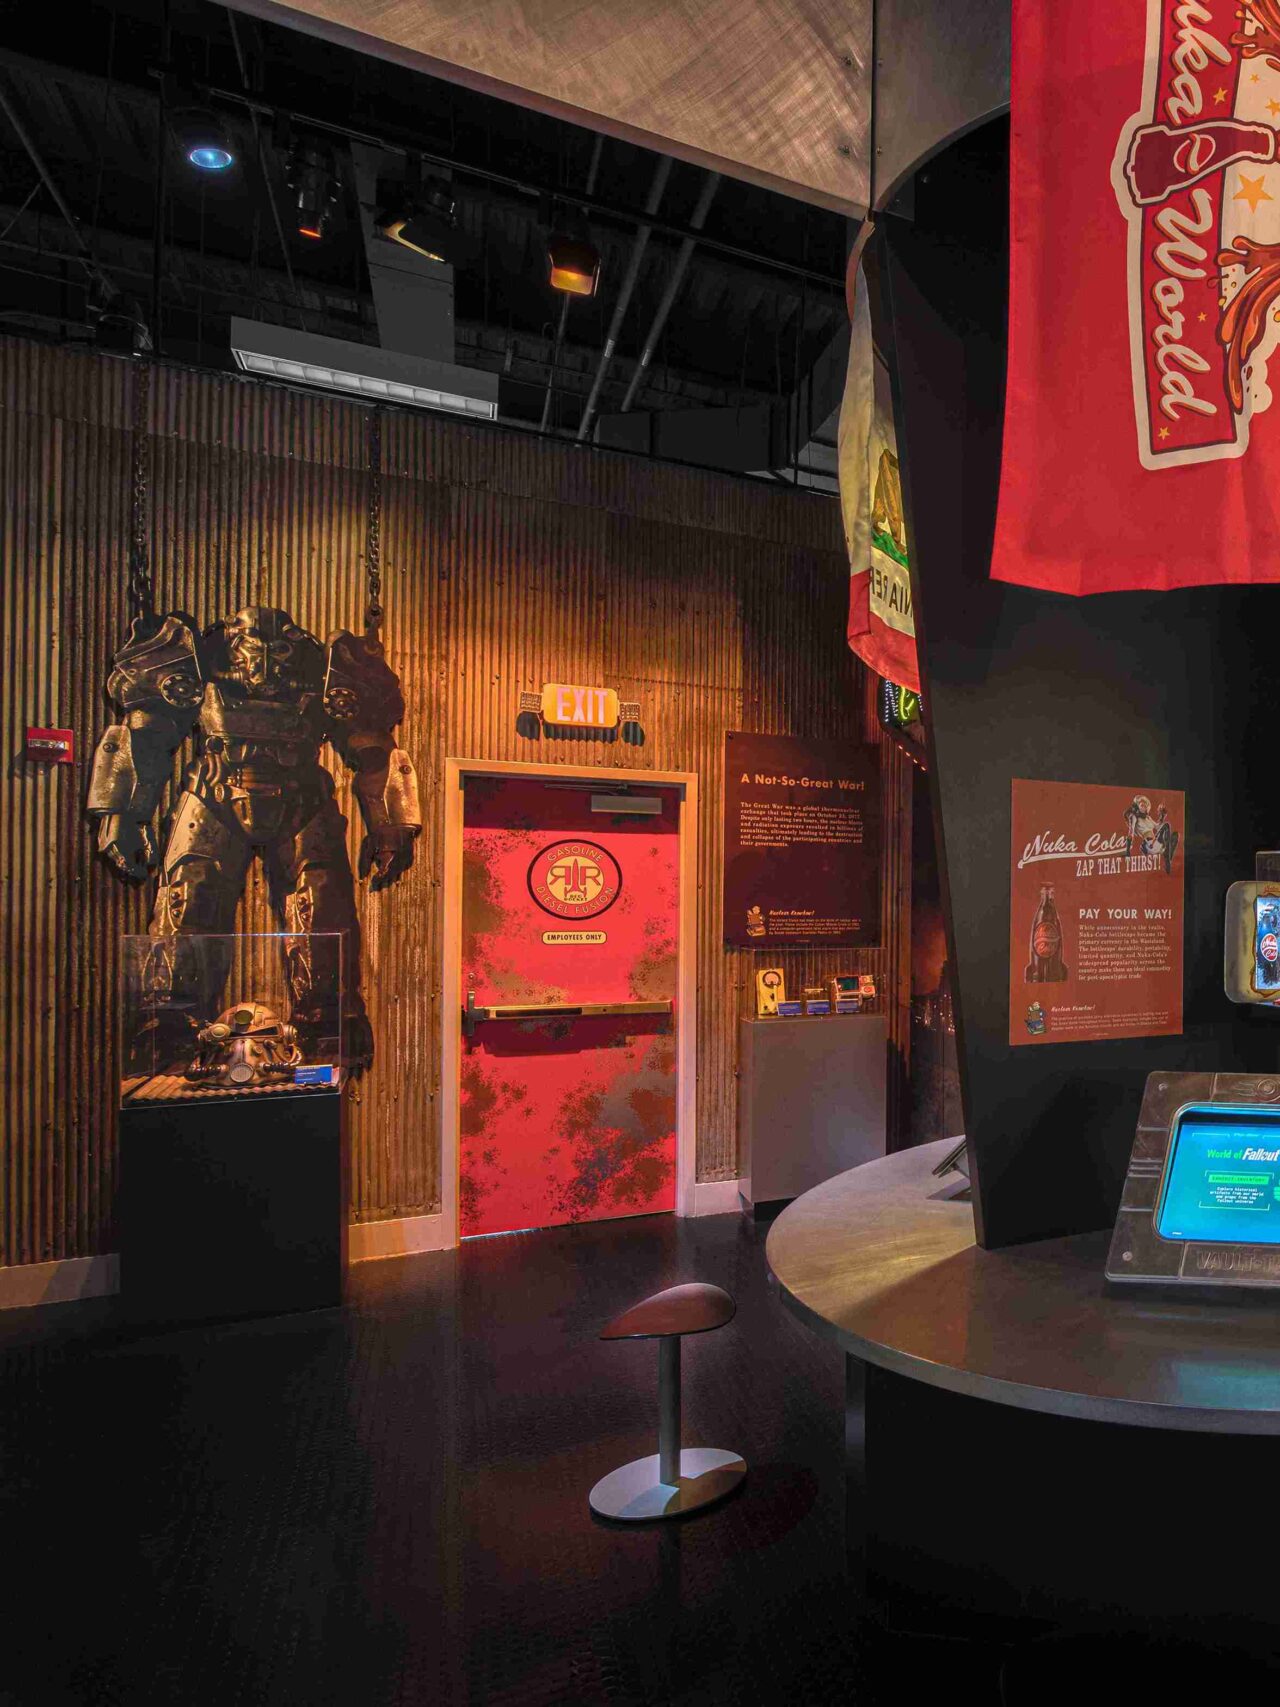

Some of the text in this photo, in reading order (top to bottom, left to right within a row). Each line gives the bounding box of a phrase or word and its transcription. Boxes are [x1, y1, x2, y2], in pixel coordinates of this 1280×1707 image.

[1150, 187, 1217, 422] World
[556, 687, 608, 724] EXIT
[741, 773, 864, 790] A Not-So-Great War!
[547, 846, 603, 861] GASOLINE
[1023, 831, 1126, 861] Nuka Cola
[1076, 854, 1161, 877] ZAP THAT THIRST!
[536, 886, 613, 913] DIESEL FUSION
[1080, 909, 1172, 919] PAY YOUR WAY!
[1207, 1148, 1280, 1161] World of Fallout
